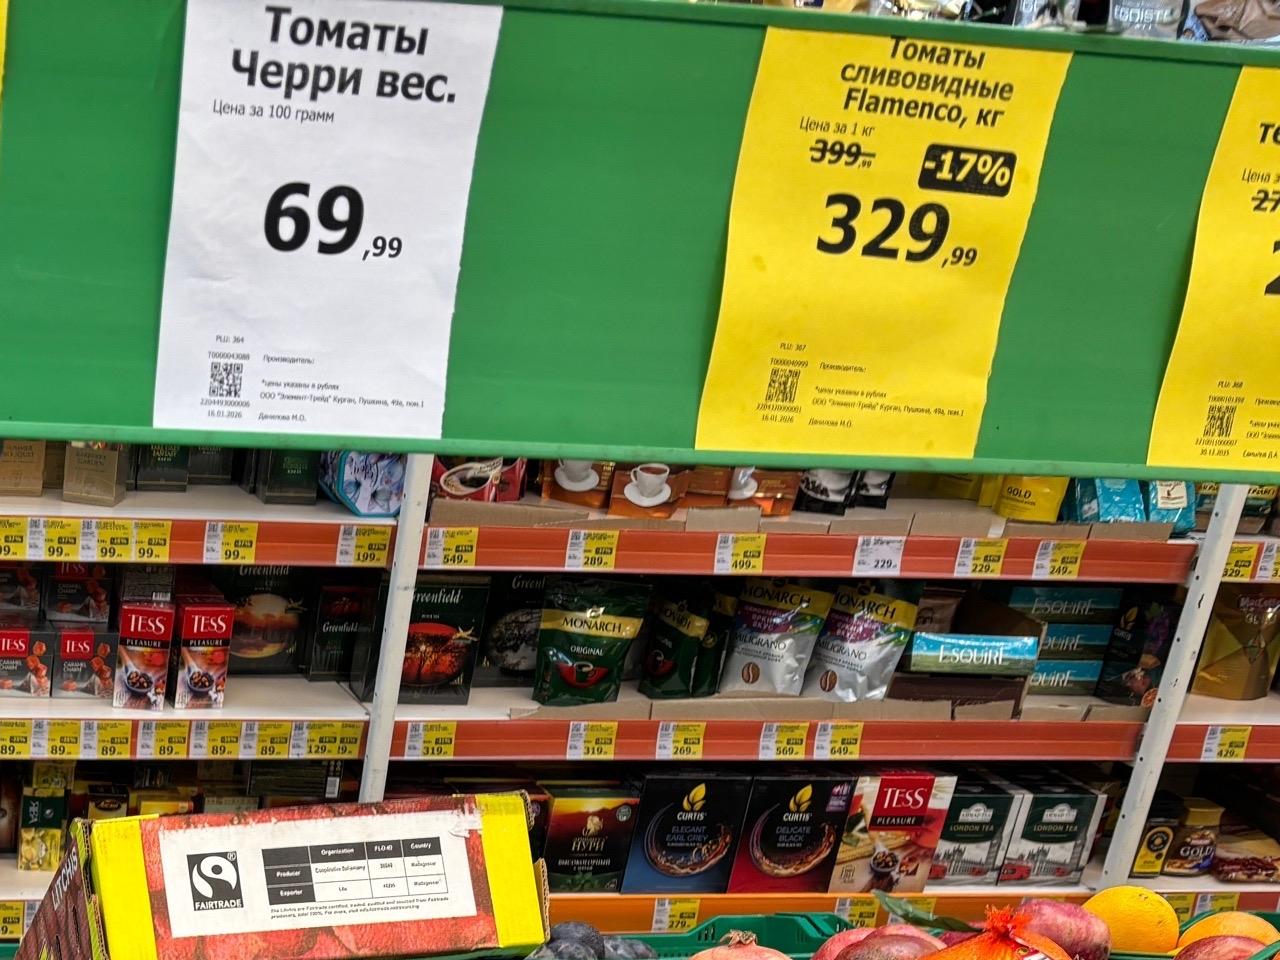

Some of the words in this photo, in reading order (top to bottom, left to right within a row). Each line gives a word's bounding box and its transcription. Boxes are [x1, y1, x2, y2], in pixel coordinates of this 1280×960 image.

[265, 6, 429, 55] Томаты
[890, 35, 985, 70] Томаты
[231, 48, 363, 101] Черри
[376, 69, 456, 103] вес.
[840, 63, 1014, 101] сливовидные
[213, 99, 245, 116] Цена
[249, 105, 263, 117] за
[269, 103, 291, 120] 100
[295, 108, 335, 124] грамм
[844, 87, 968, 129] Flamenco,
[976, 107, 1005, 128] кг
[800, 116, 829, 133] Цена
[834, 122, 847, 134] за
[852, 123, 857, 135] 1
[862, 124, 875, 137] кг
[924, 150, 1010, 187] -17%
[1242, 168, 1271, 185] Цена
[232, 335, 244, 343] 364
[239, 565, 291, 576] Greenfield
[741, 585, 812, 605] MONARCH
[128, 614, 166, 635] TESS
[191, 614, 227, 633] TESS
[322, 620, 359, 633] Greenfield
[562, 617, 622, 634] MONARCH
[1, 638, 26, 650] TESS
[66, 640, 90, 652] TESS
[126, 638, 162, 647] PLEASURE
[190, 639, 223, 647] PLEASURE
[570, 645, 604, 657] ORIGINAL
[883, 786, 928, 809] TESS
[677, 812, 705, 822] CURTIS
[783, 812, 810, 822] CURTIS
[876, 816, 918, 826] PLEASURE
[671, 825, 706, 834] ELEGANT
[776, 825, 811, 834] DELICATE
[666, 833, 684, 842] EARL
[686, 833, 708, 842] GREY
[778, 834, 804, 842] BLACK
[51, 846, 78, 911] LITCHIS
[276, 870, 301, 878] Producer
[280, 889, 303, 897] Exporter
[194, 898, 243, 912] FAIRTRADE
